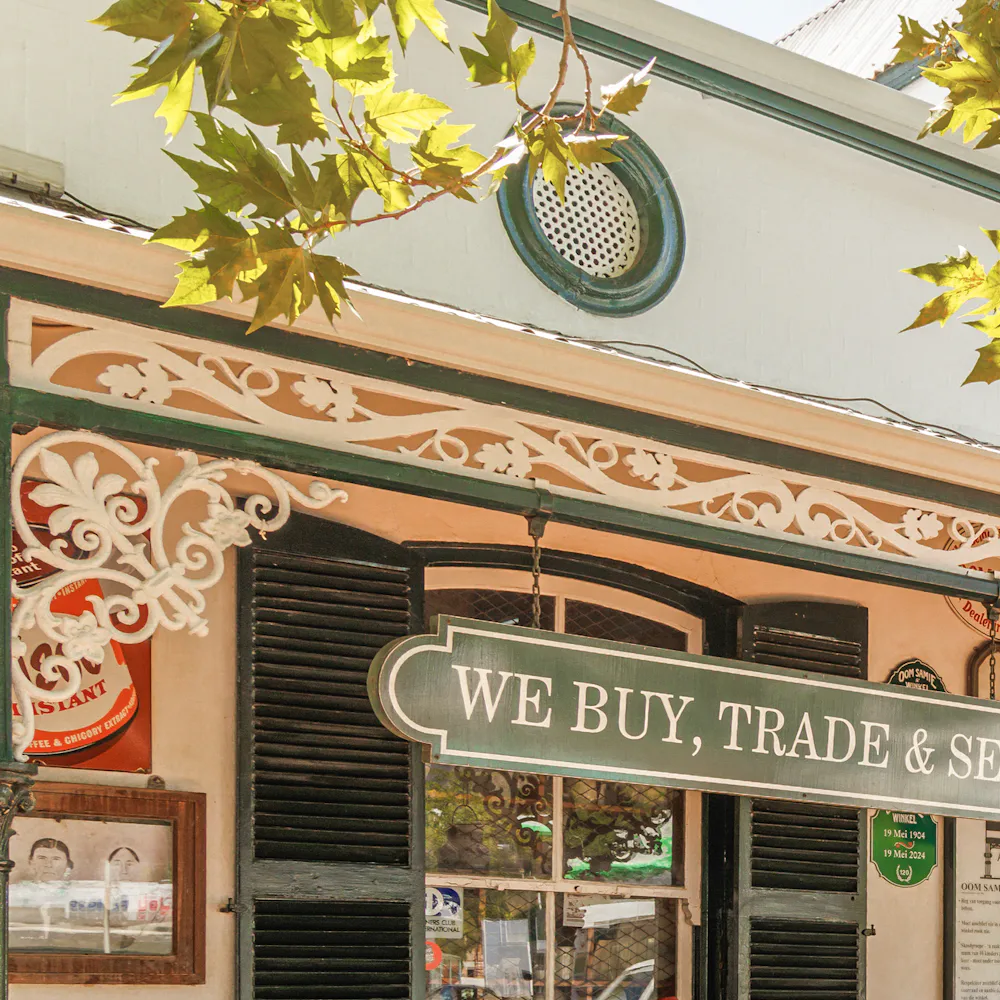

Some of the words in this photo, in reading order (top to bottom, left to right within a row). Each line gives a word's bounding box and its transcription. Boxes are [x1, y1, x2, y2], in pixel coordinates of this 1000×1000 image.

[898, 669, 914, 683] OOM
[915, 668, 937, 690] SAMIE
[64, 725, 104, 746] CHICORY
[104, 707, 129, 731] EXTRACT
[451, 665, 552, 729] WE
[570, 680, 702, 757] BUY,
[718, 701, 891, 769] TRADE
[905, 728, 935, 775] &
[892, 812, 917, 825] WINKEL
[883, 829, 892, 837] 19
[893, 829, 908, 839] Mei
[909, 830, 926, 840] 1904
[883, 849, 892, 858] 19
[893, 849, 908, 859] Mei
[909, 850, 926, 860] 2024
[961, 882, 982, 892] OOM
